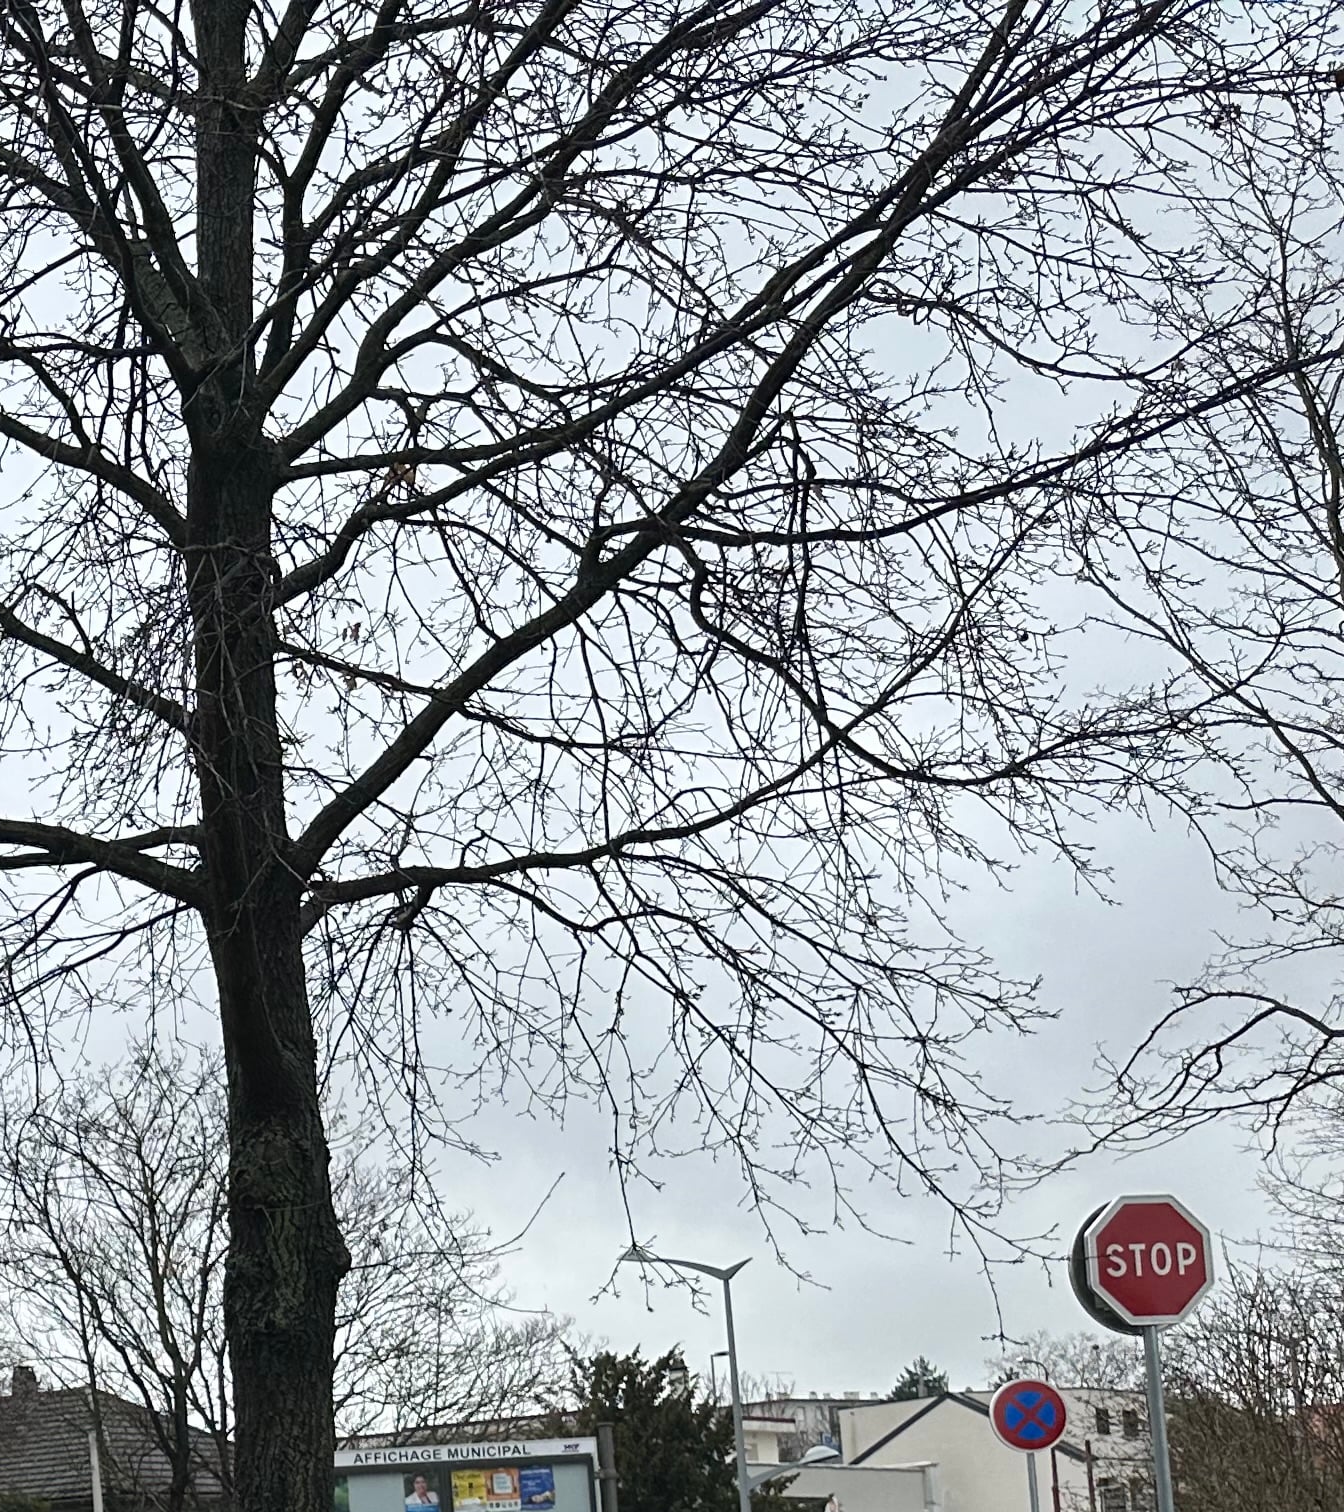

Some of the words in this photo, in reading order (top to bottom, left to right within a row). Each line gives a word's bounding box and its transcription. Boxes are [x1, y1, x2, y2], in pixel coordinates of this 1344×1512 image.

[1106, 1242, 1197, 1277] STOP
[353, 1448, 442, 1464] AFFICHAGE
[447, 1445, 531, 1460] MUNICIPAL
